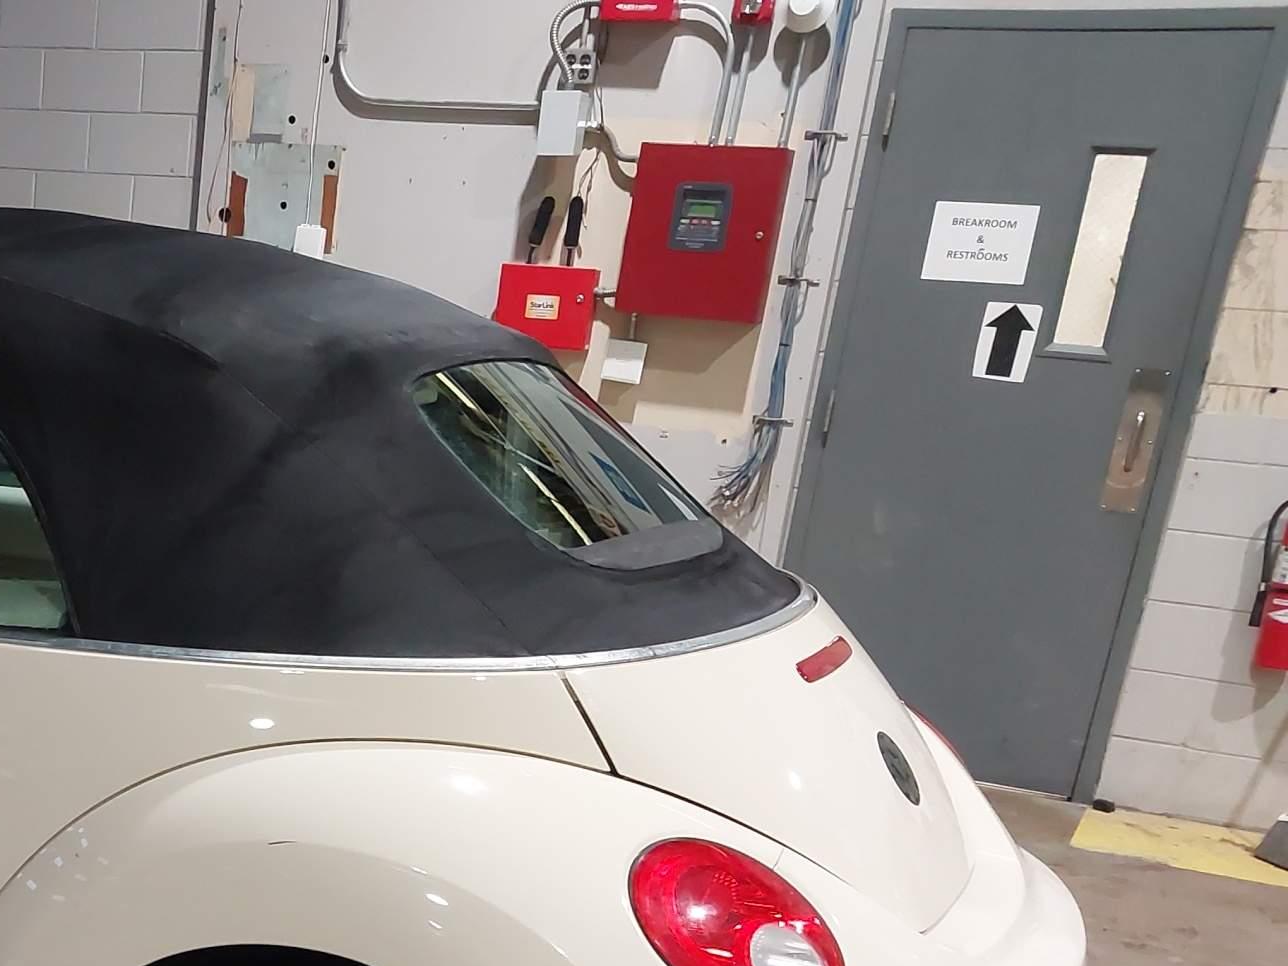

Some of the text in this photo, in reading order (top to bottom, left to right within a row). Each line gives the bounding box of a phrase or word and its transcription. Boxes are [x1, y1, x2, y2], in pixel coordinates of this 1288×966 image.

[952, 217, 1018, 228] BREAKROOM
[976, 234, 985, 244] &
[946, 250, 1009, 262] RESTROOMS
